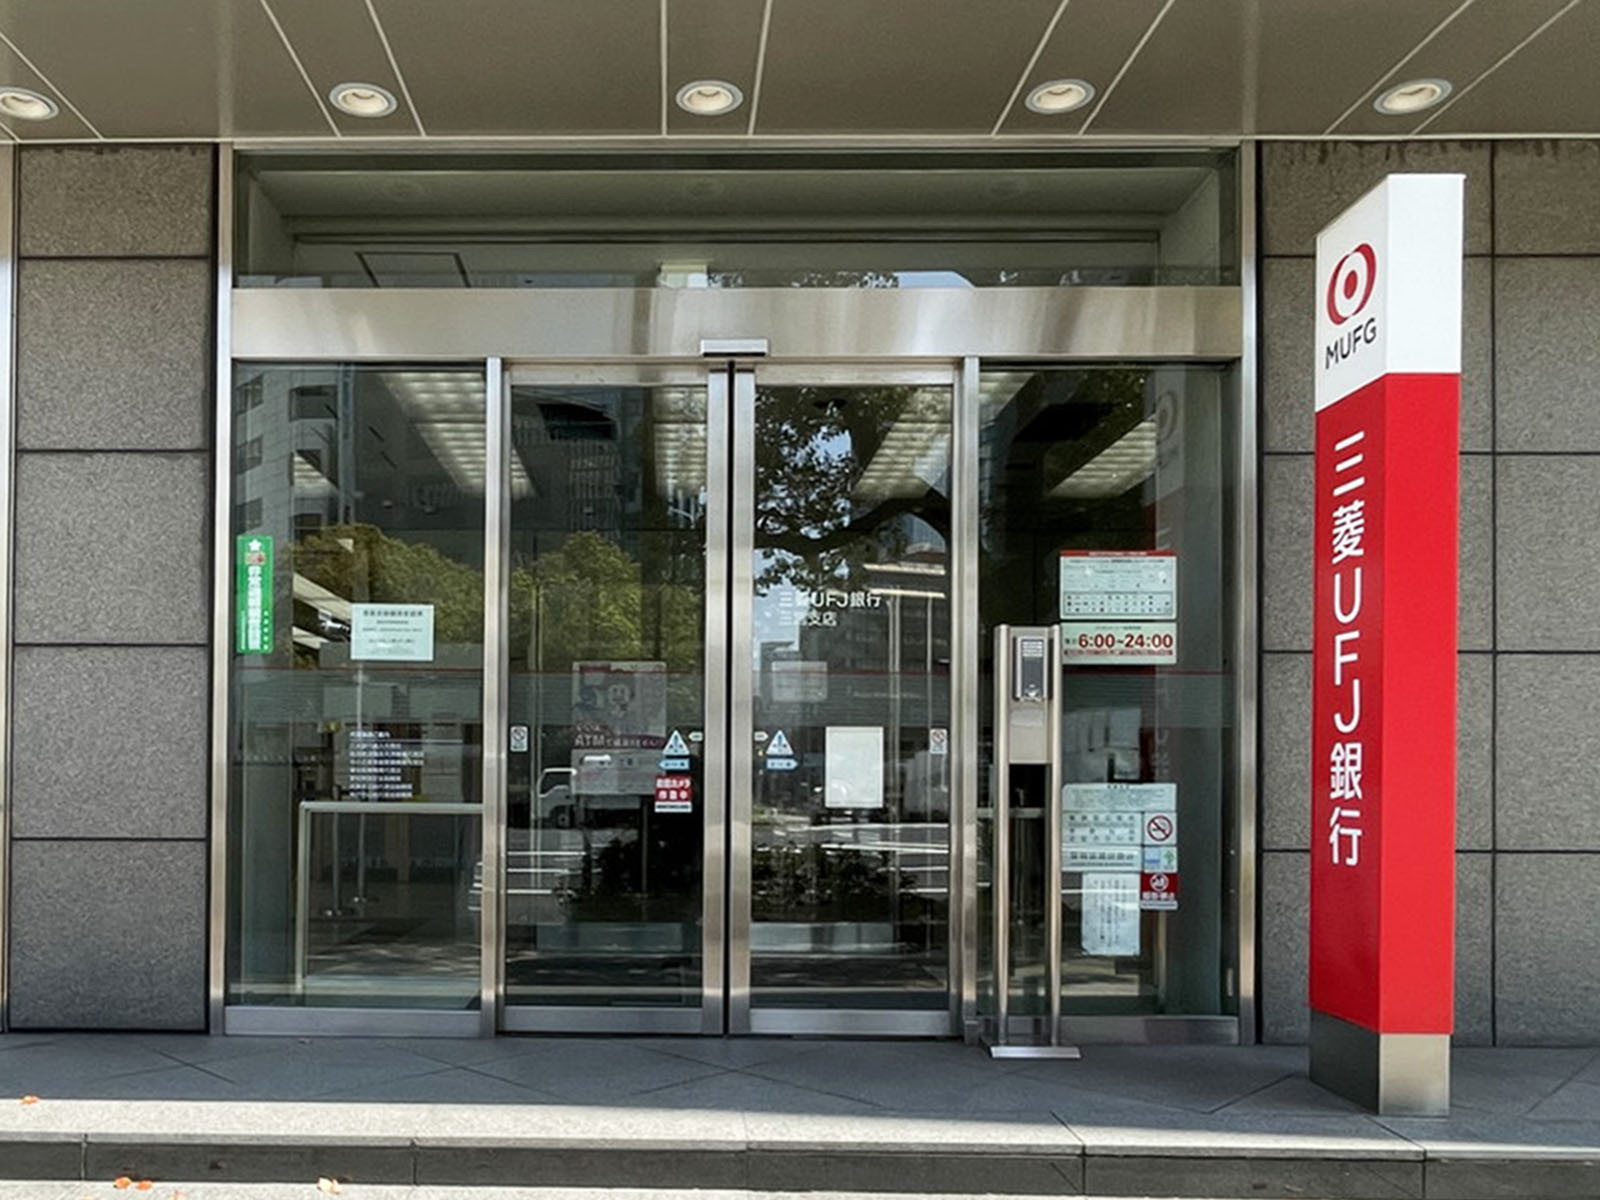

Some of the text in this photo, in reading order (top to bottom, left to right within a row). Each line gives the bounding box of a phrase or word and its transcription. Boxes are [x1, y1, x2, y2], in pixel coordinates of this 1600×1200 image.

[1324, 317, 1378, 370] MUFG
[779, 610, 838, 627] 三支店
[1329, 430, 1366, 867] 三菱UFJ銀行
